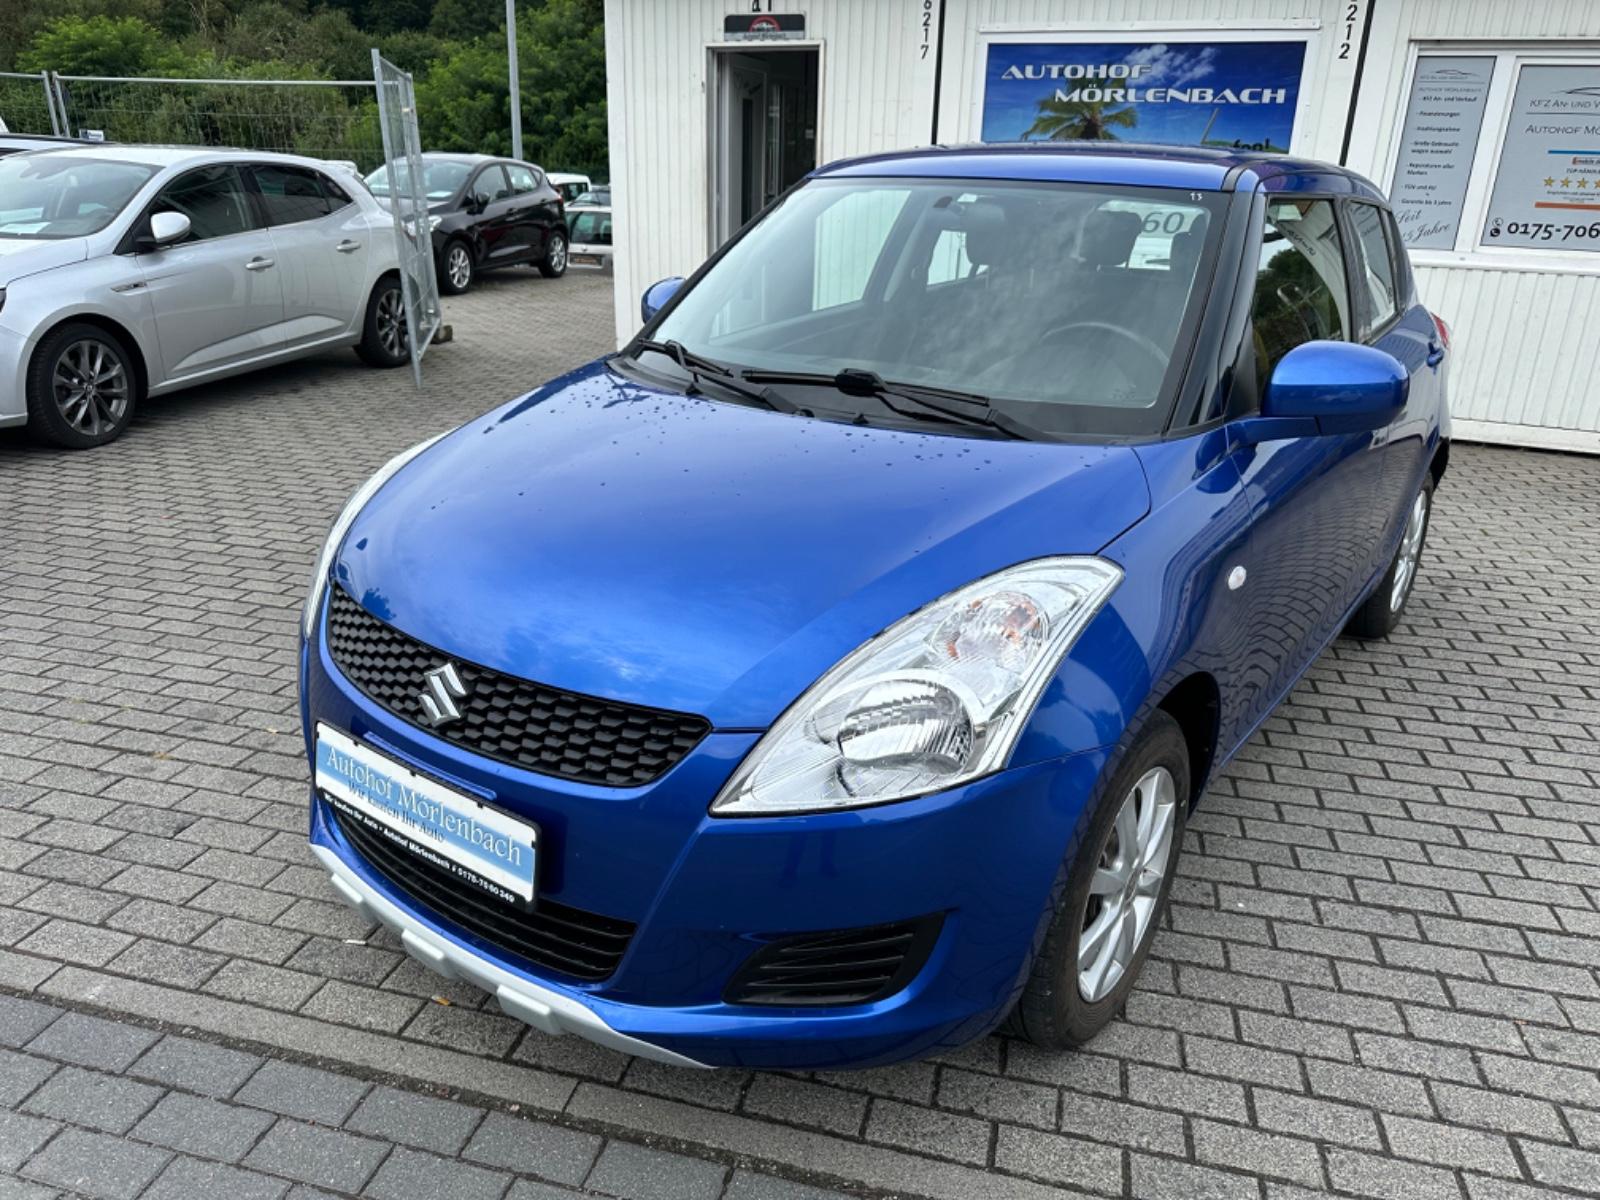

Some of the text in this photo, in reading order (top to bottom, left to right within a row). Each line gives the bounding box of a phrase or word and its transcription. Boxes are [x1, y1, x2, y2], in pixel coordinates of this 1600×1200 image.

[1001, 64, 1152, 80] AUTOHOF
[1054, 83, 1286, 105] MÖRLENBACH
[1525, 124, 1582, 135] AUTOHOF
[1507, 221, 1600, 241] 0175-706
[326, 747, 521, 867] Autohof Mörlenbach
